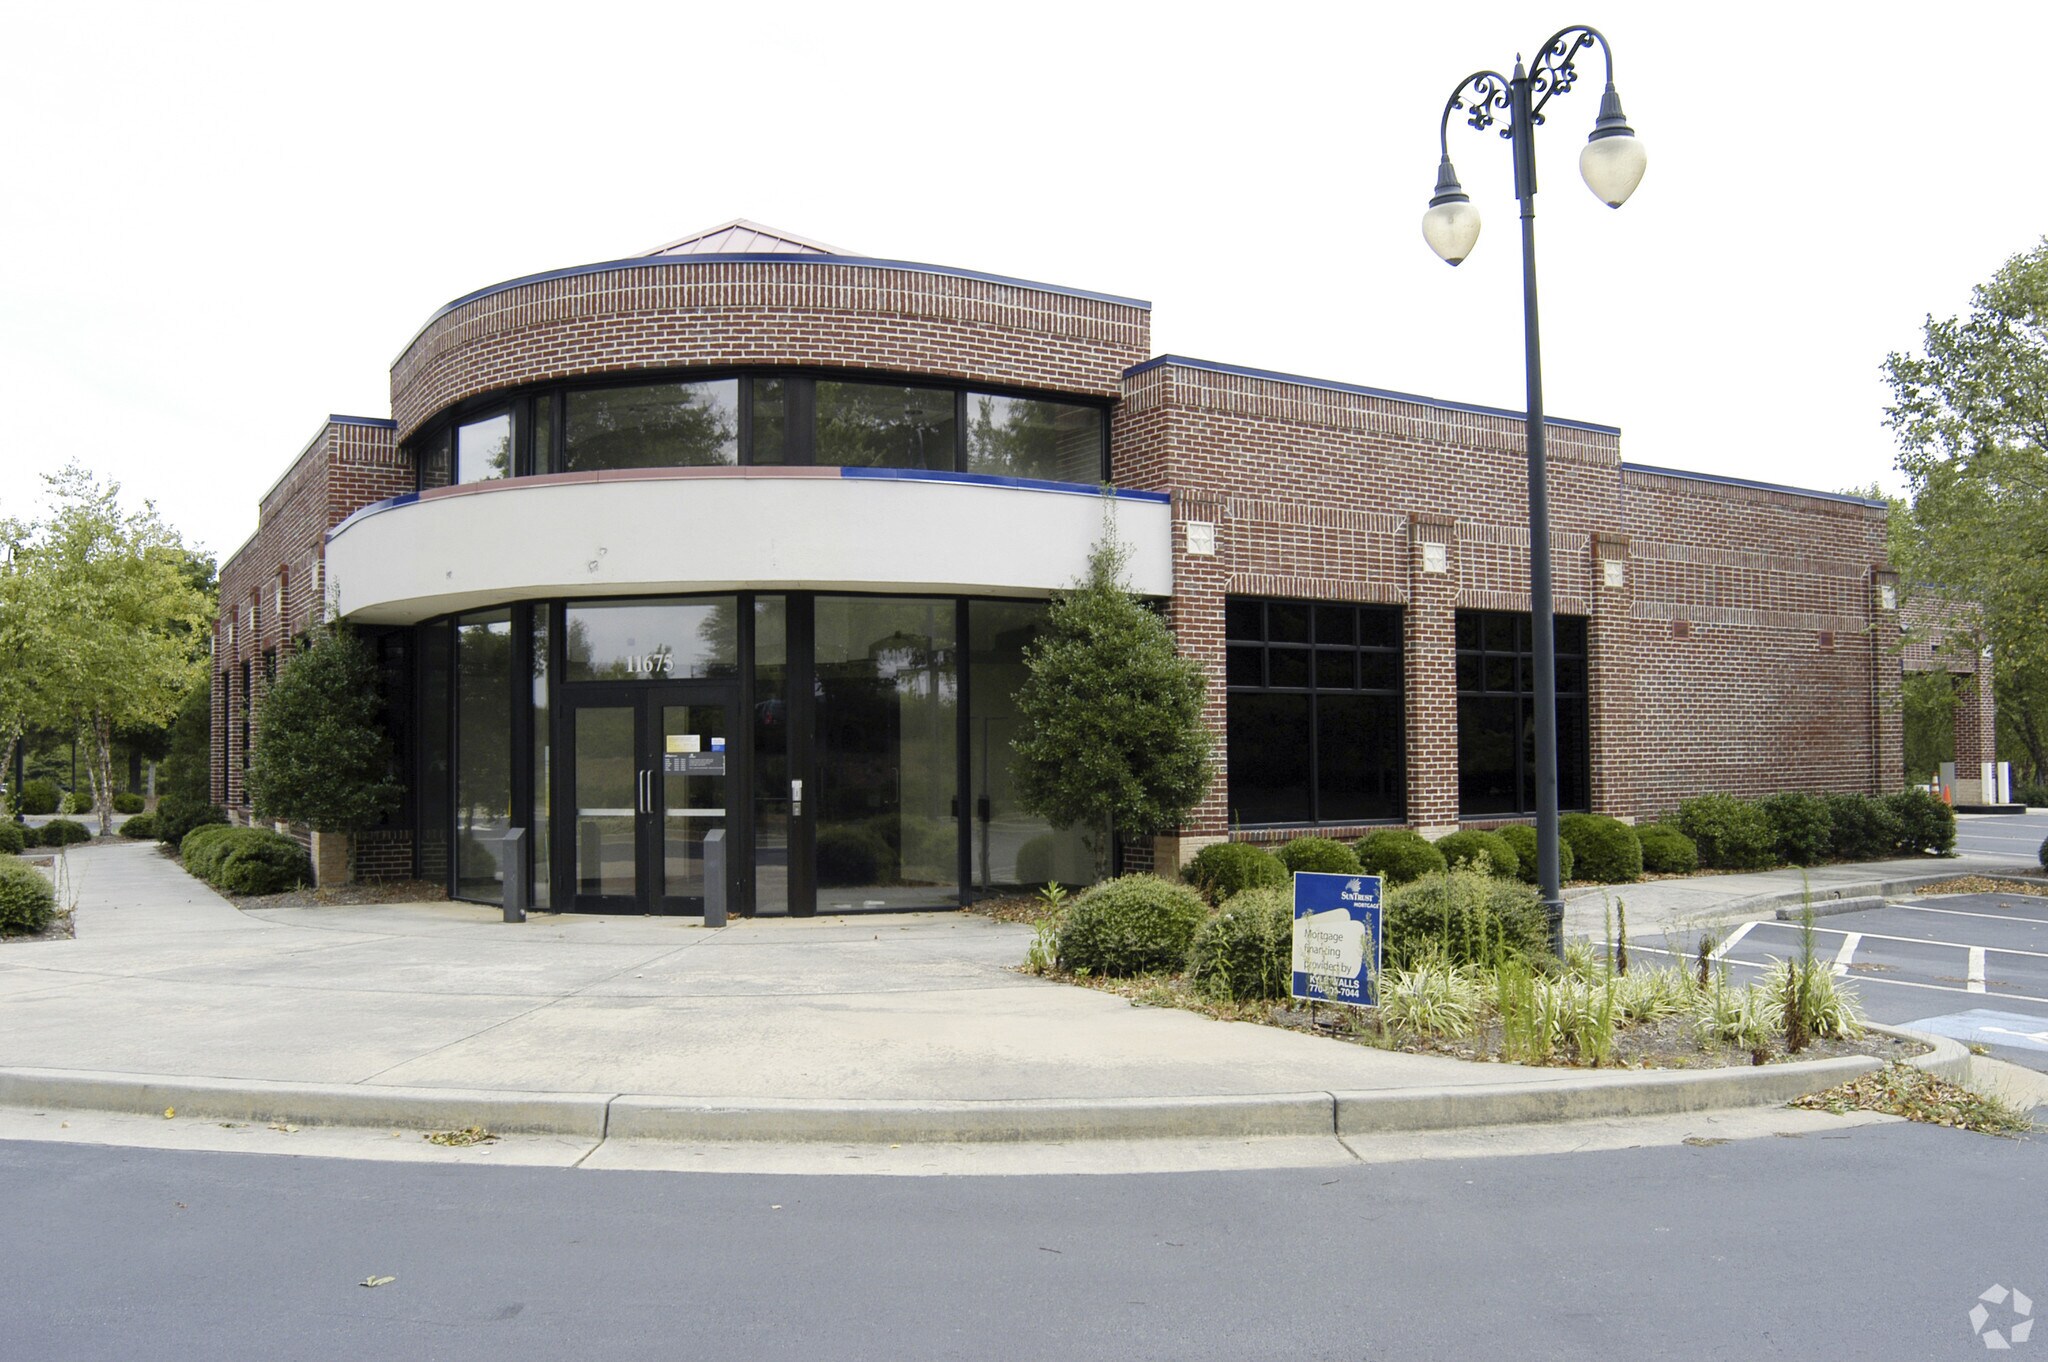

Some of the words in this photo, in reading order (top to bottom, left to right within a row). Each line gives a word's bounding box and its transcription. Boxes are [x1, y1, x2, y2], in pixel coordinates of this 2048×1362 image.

[626, 654, 674, 672] 11675
[1341, 891, 1374, 902] SUNTRUST
[1304, 929, 1343, 943] Mortgage
[1341, 962, 1352, 975] by
